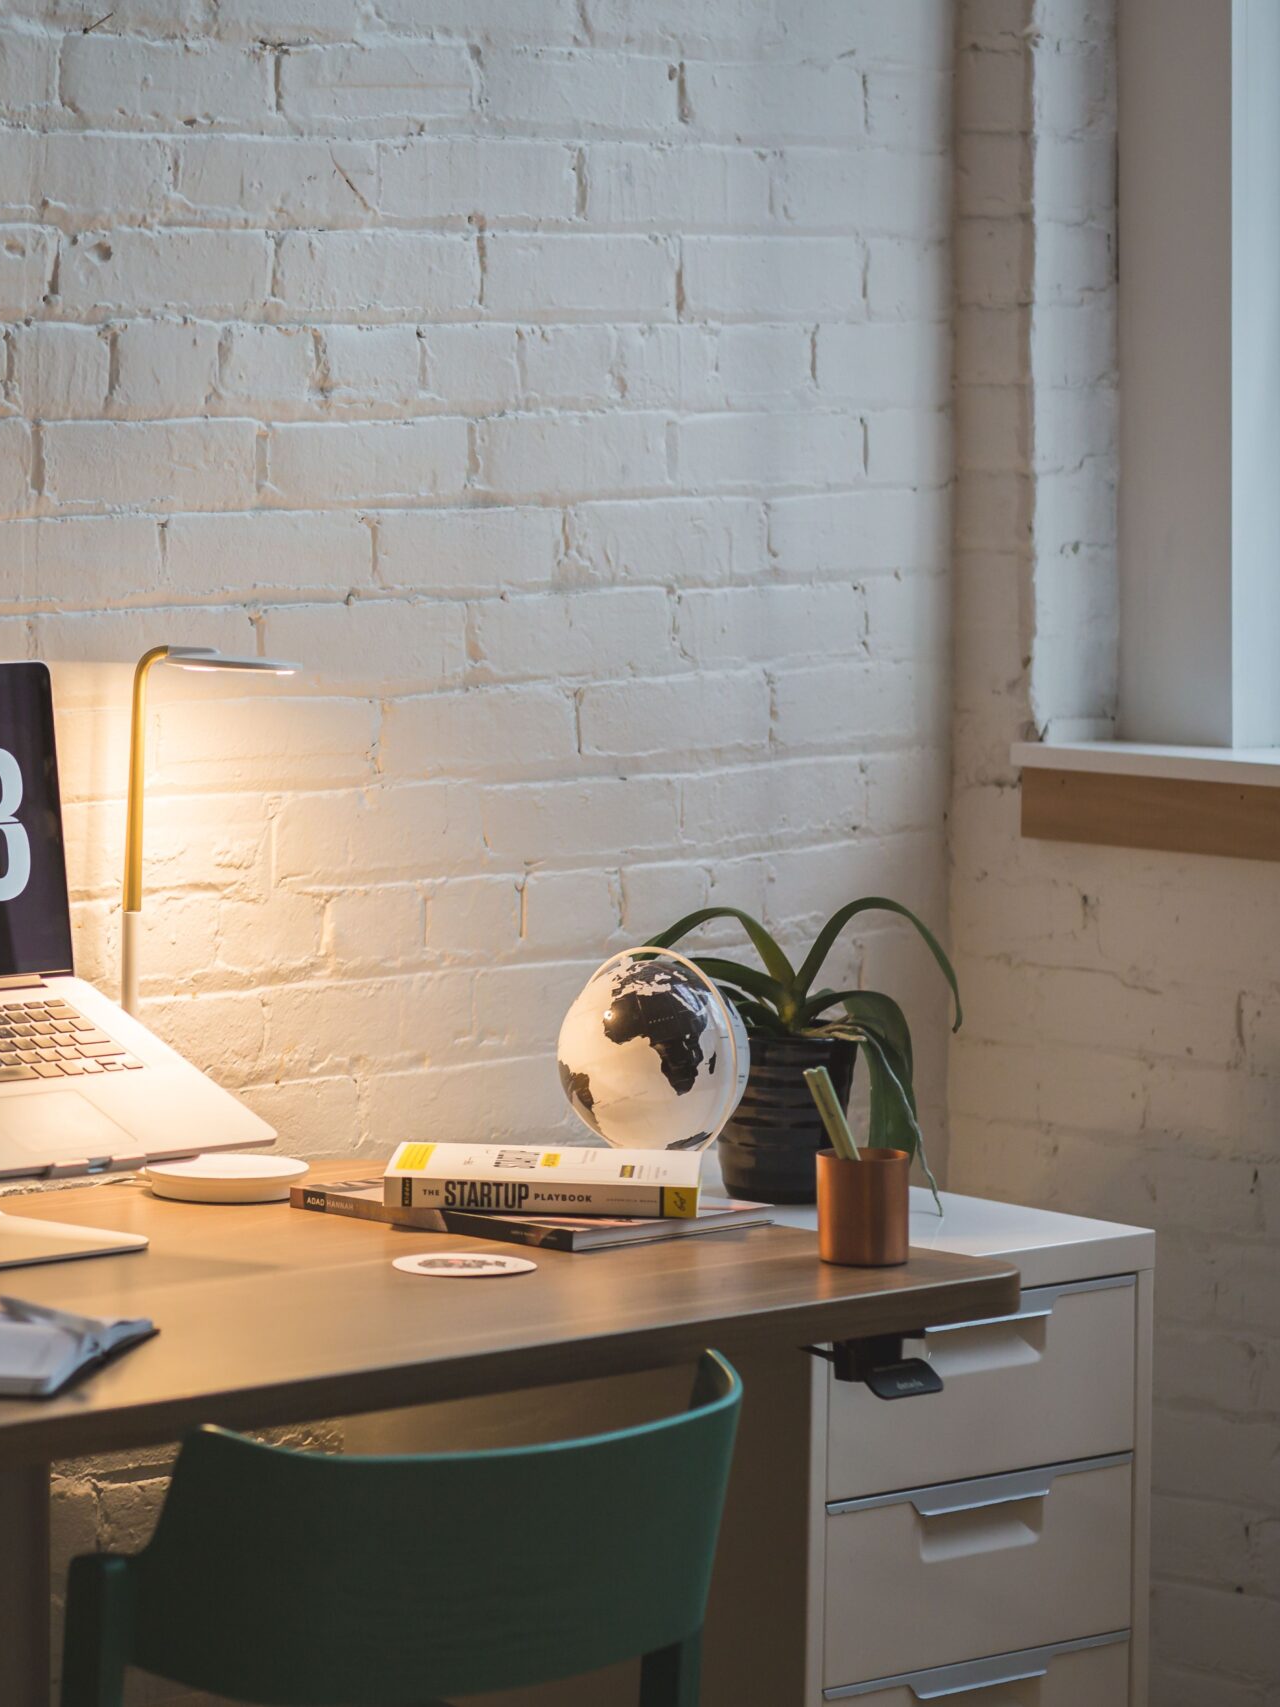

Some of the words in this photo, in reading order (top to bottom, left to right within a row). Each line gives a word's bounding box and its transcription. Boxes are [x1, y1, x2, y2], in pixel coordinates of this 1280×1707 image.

[422, 1188, 440, 1197] THE
[444, 1180, 530, 1209] STARTUP
[533, 1192, 593, 1203] PLAYBOOK
[326, 1200, 354, 1211] HANNAH
